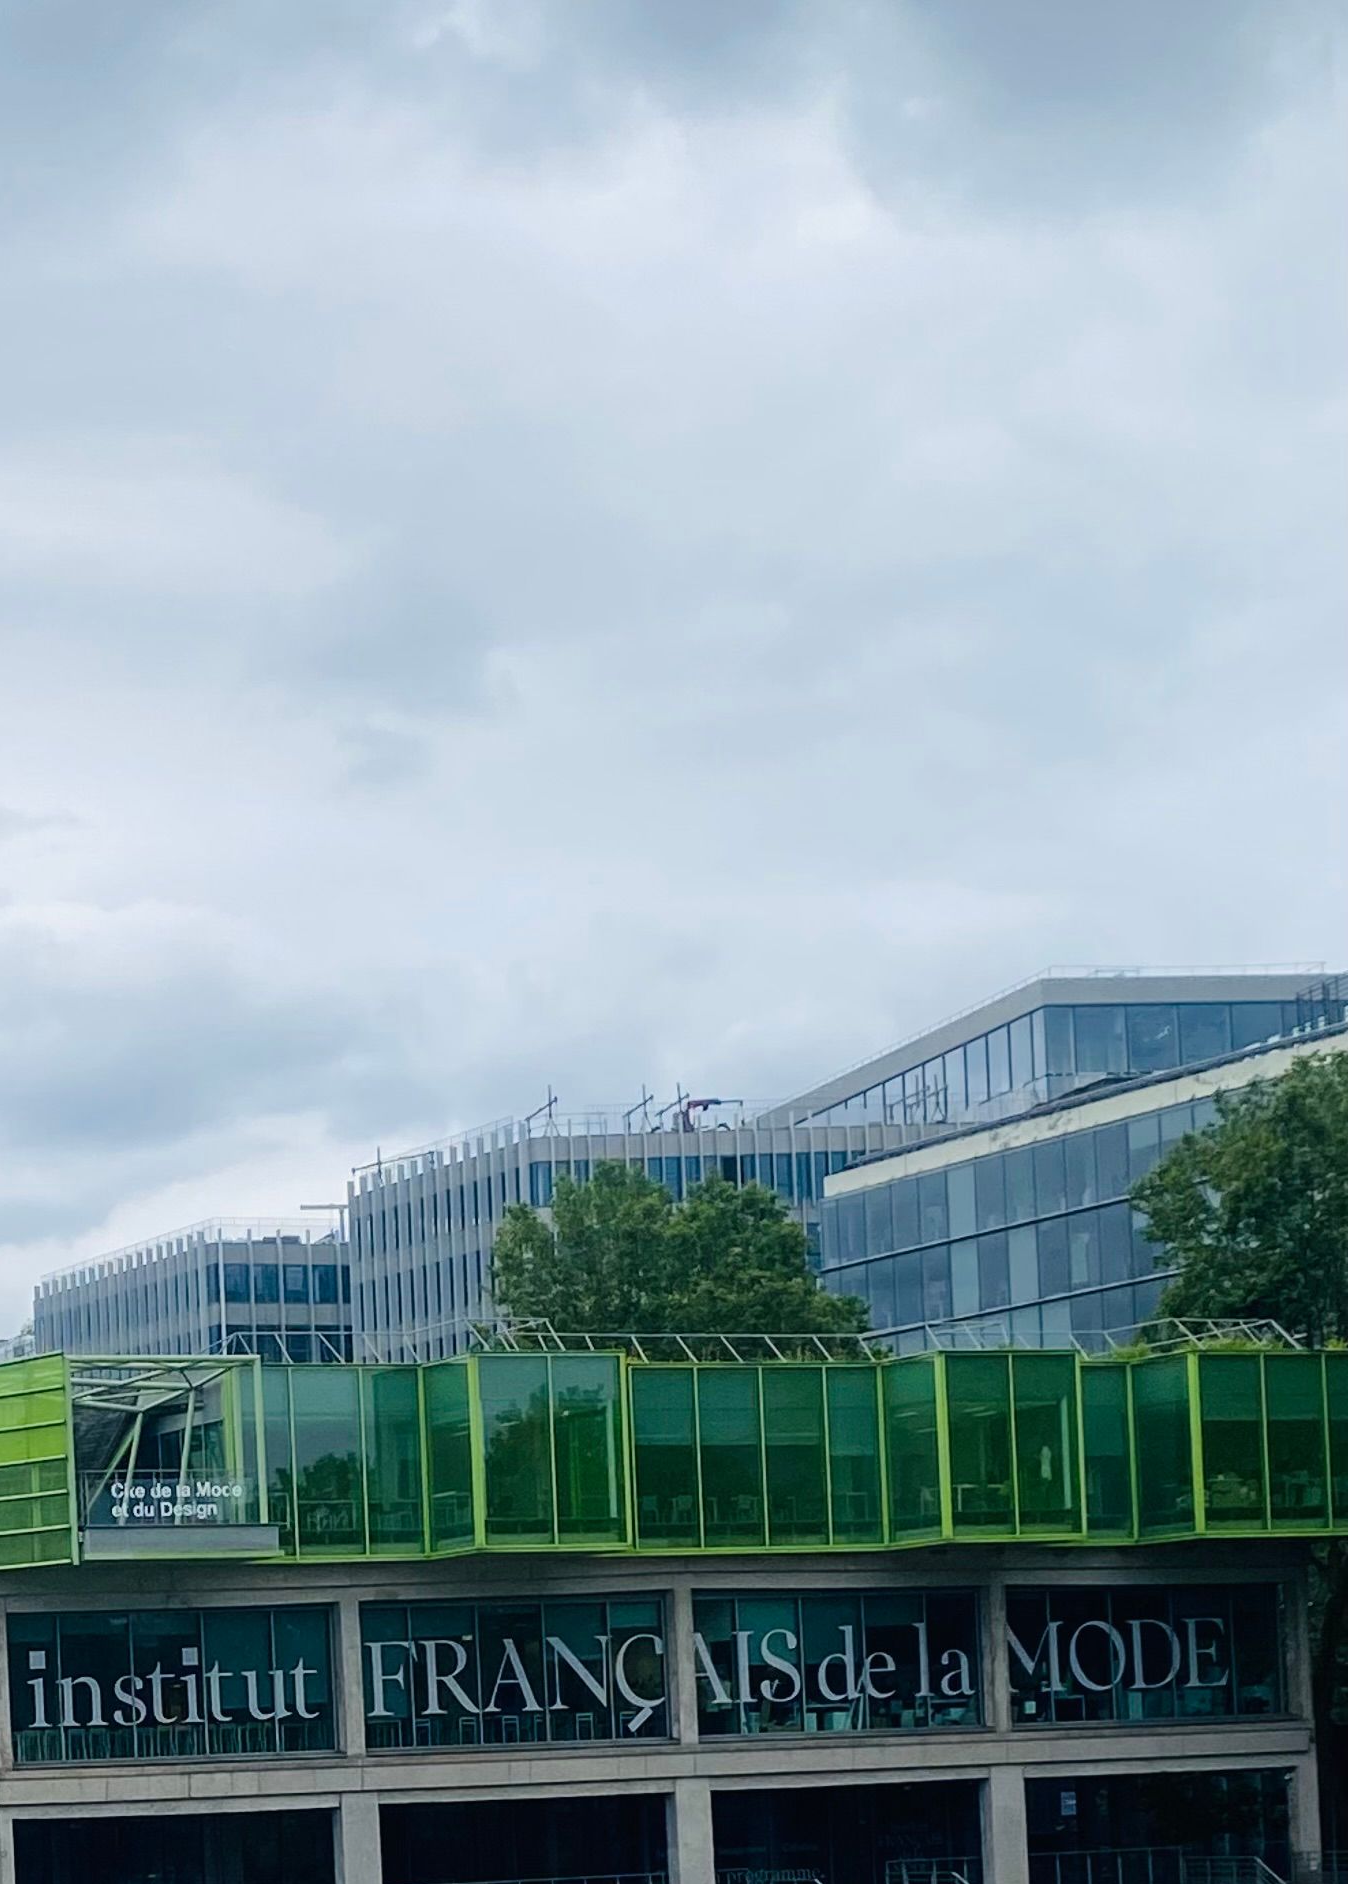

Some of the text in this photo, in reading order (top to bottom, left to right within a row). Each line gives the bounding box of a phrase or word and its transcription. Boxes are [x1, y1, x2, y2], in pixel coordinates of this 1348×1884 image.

[150, 1482, 172, 1498] de
[176, 1484, 191, 1497] la
[111, 1501, 218, 1519] et du Design
[27, 1617, 1229, 1732] institut FRANÇAIS de la MODE
